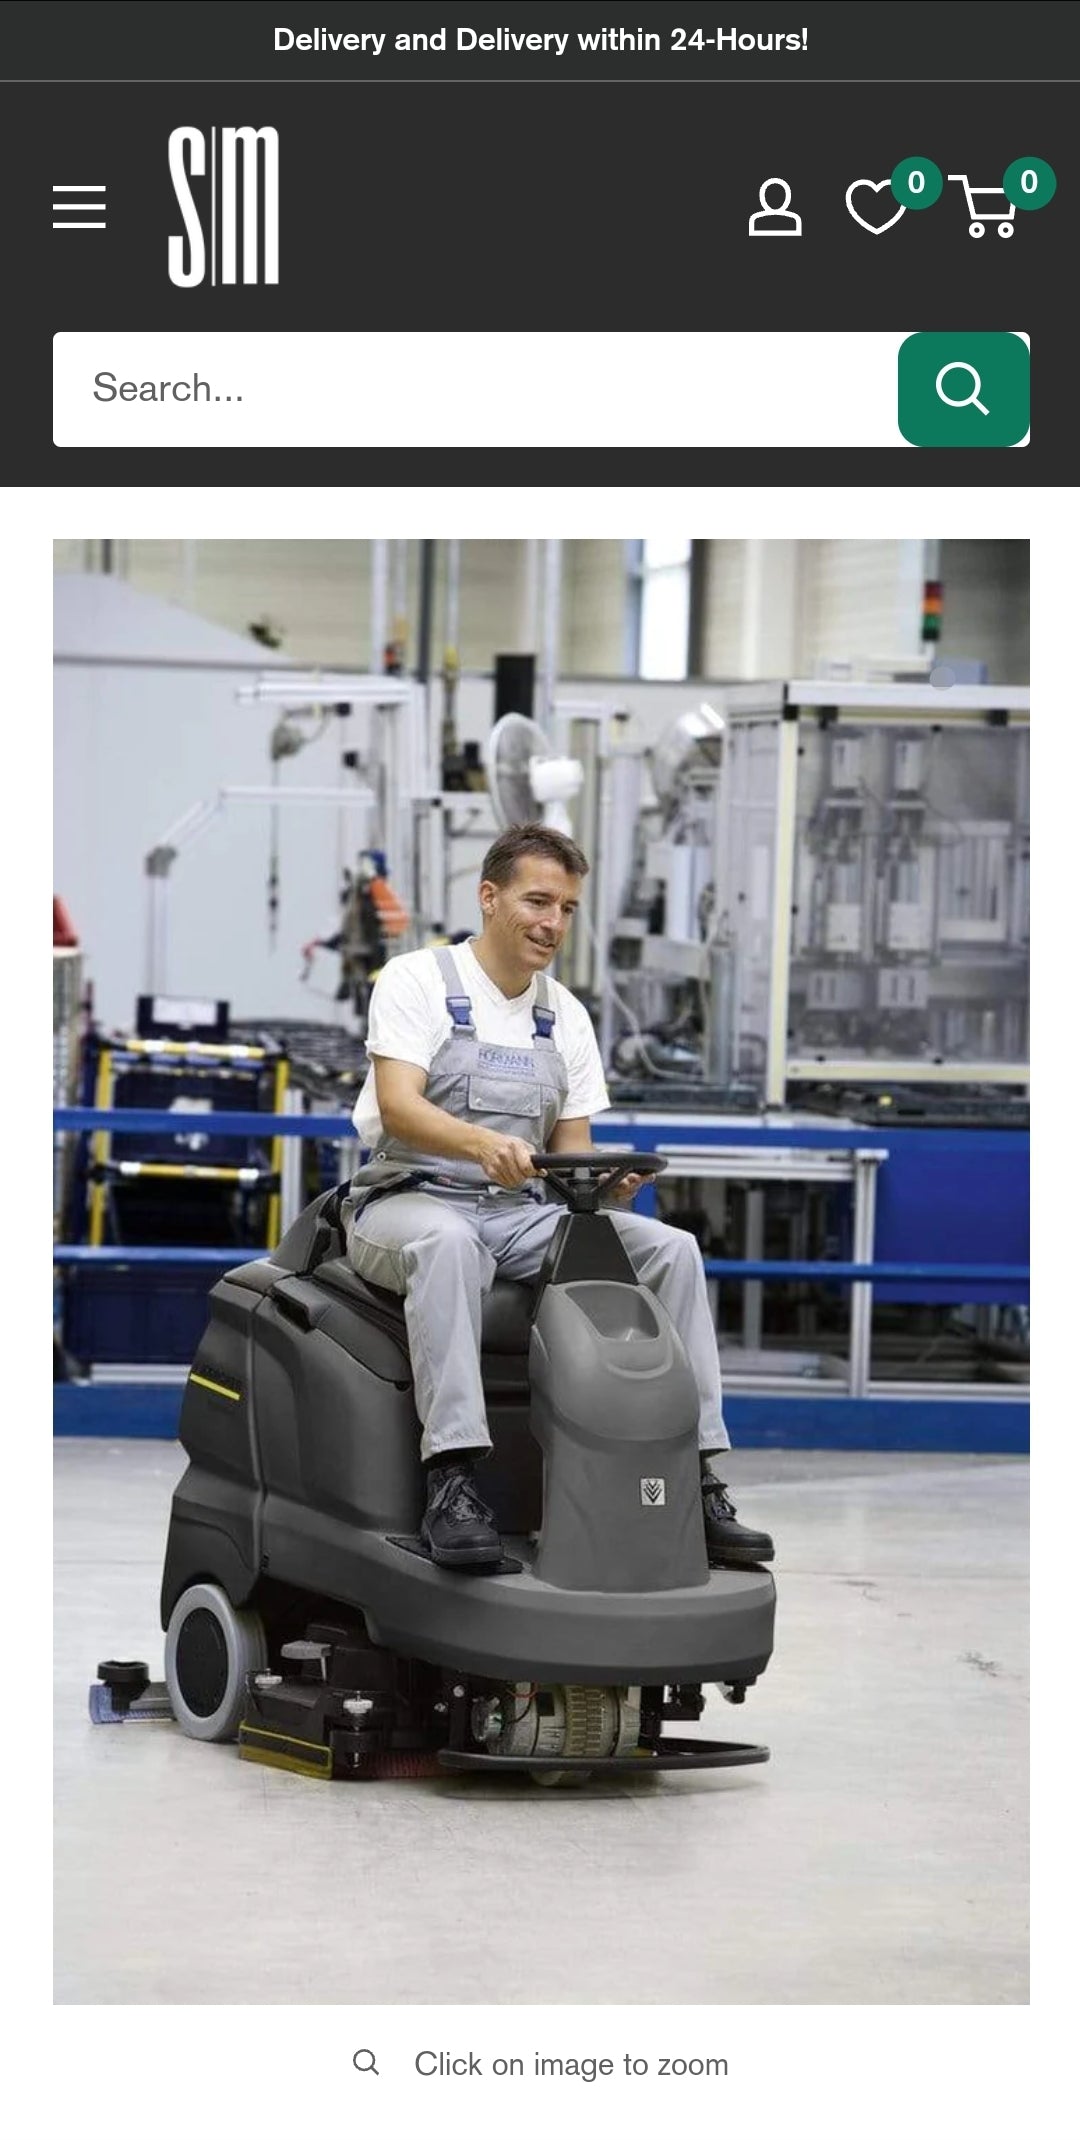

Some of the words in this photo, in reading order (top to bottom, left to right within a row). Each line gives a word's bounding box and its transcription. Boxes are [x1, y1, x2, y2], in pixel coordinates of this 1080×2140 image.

[273, 26, 388, 57] Delivery
[394, 26, 448, 52] and
[455, 26, 570, 57] Delivery
[576, 26, 662, 52] within
[669, 26, 809, 52] 24-Hours!
[906, 169, 926, 195] 0
[1019, 168, 1039, 195] 0
[91, 370, 244, 404] Search...
[413, 2049, 484, 2077] Click
[491, 2057, 525, 2077] on
[533, 2050, 614, 2083] image
[621, 2052, 649, 2077] to
[656, 2057, 729, 2077] zoom
